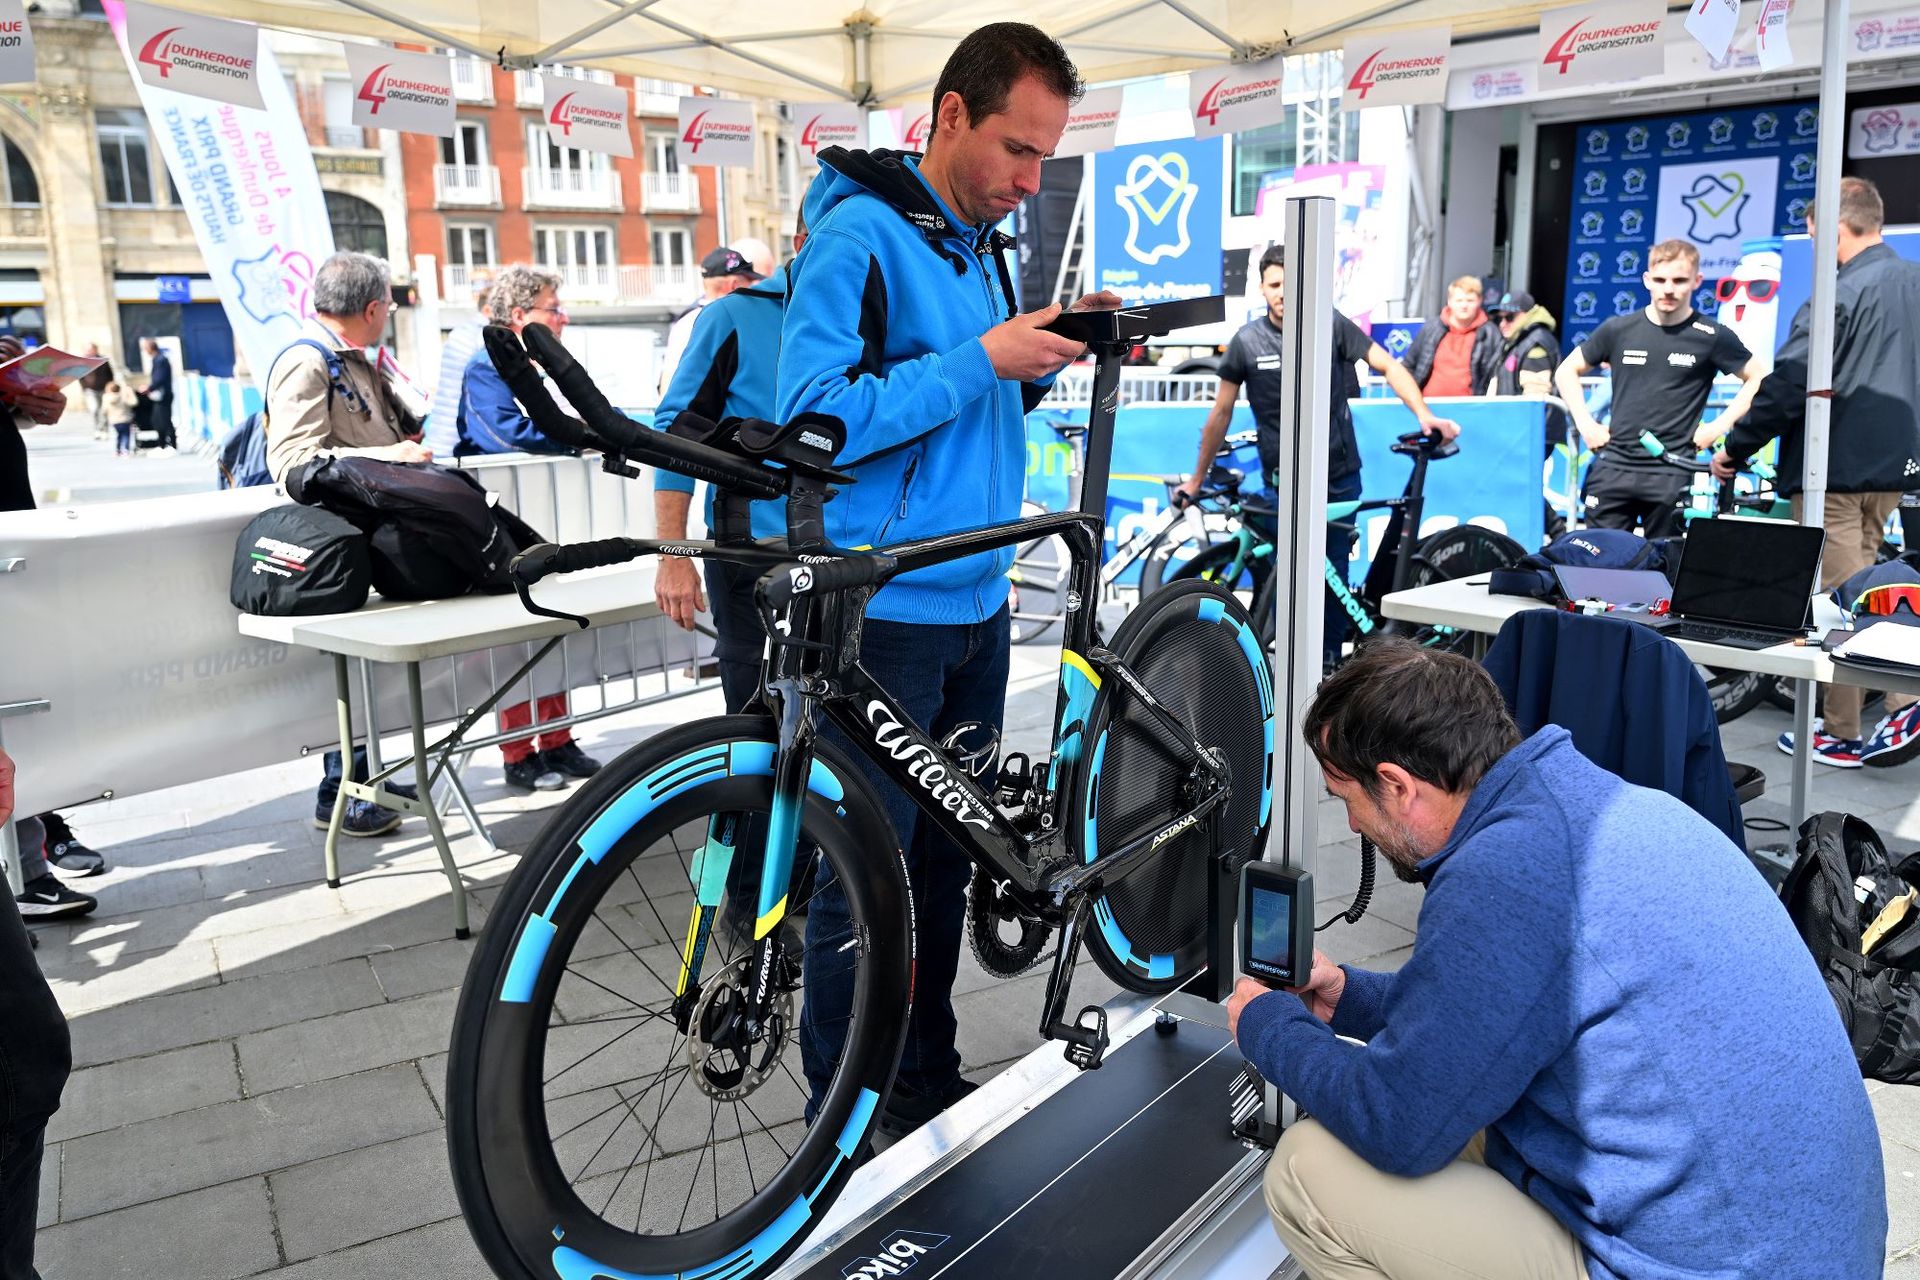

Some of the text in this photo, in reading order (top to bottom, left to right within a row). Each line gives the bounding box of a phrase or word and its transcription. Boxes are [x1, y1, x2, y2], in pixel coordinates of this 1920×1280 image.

[1578, 20, 1660, 42] DUNKERQUE
[1577, 33, 1654, 54] ORGANISATION
[171, 43, 252, 69] DUNKERQUE
[1376, 55, 1445, 72] DUNKERQUE
[172, 57, 249, 80] ORGANISATION
[1375, 68, 1440, 82] ORGANISATION
[387, 77, 450, 96] DUNKERQUE
[1219, 78, 1281, 99] DUNKERQUE
[387, 89, 449, 107] ORGANISATION
[1219, 87, 1277, 109] ORGANISATION
[570, 106, 623, 121] DUNKERQUE
[571, 116, 622, 130] ORGANISATION
[704, 121, 751, 133] DUNKERQUE
[704, 132, 751, 142] ORGANISATION
[866, 699, 990, 831] Wilier
[954, 780, 995, 822] TRIESTINA
[1150, 814, 1199, 852] ASTANA
